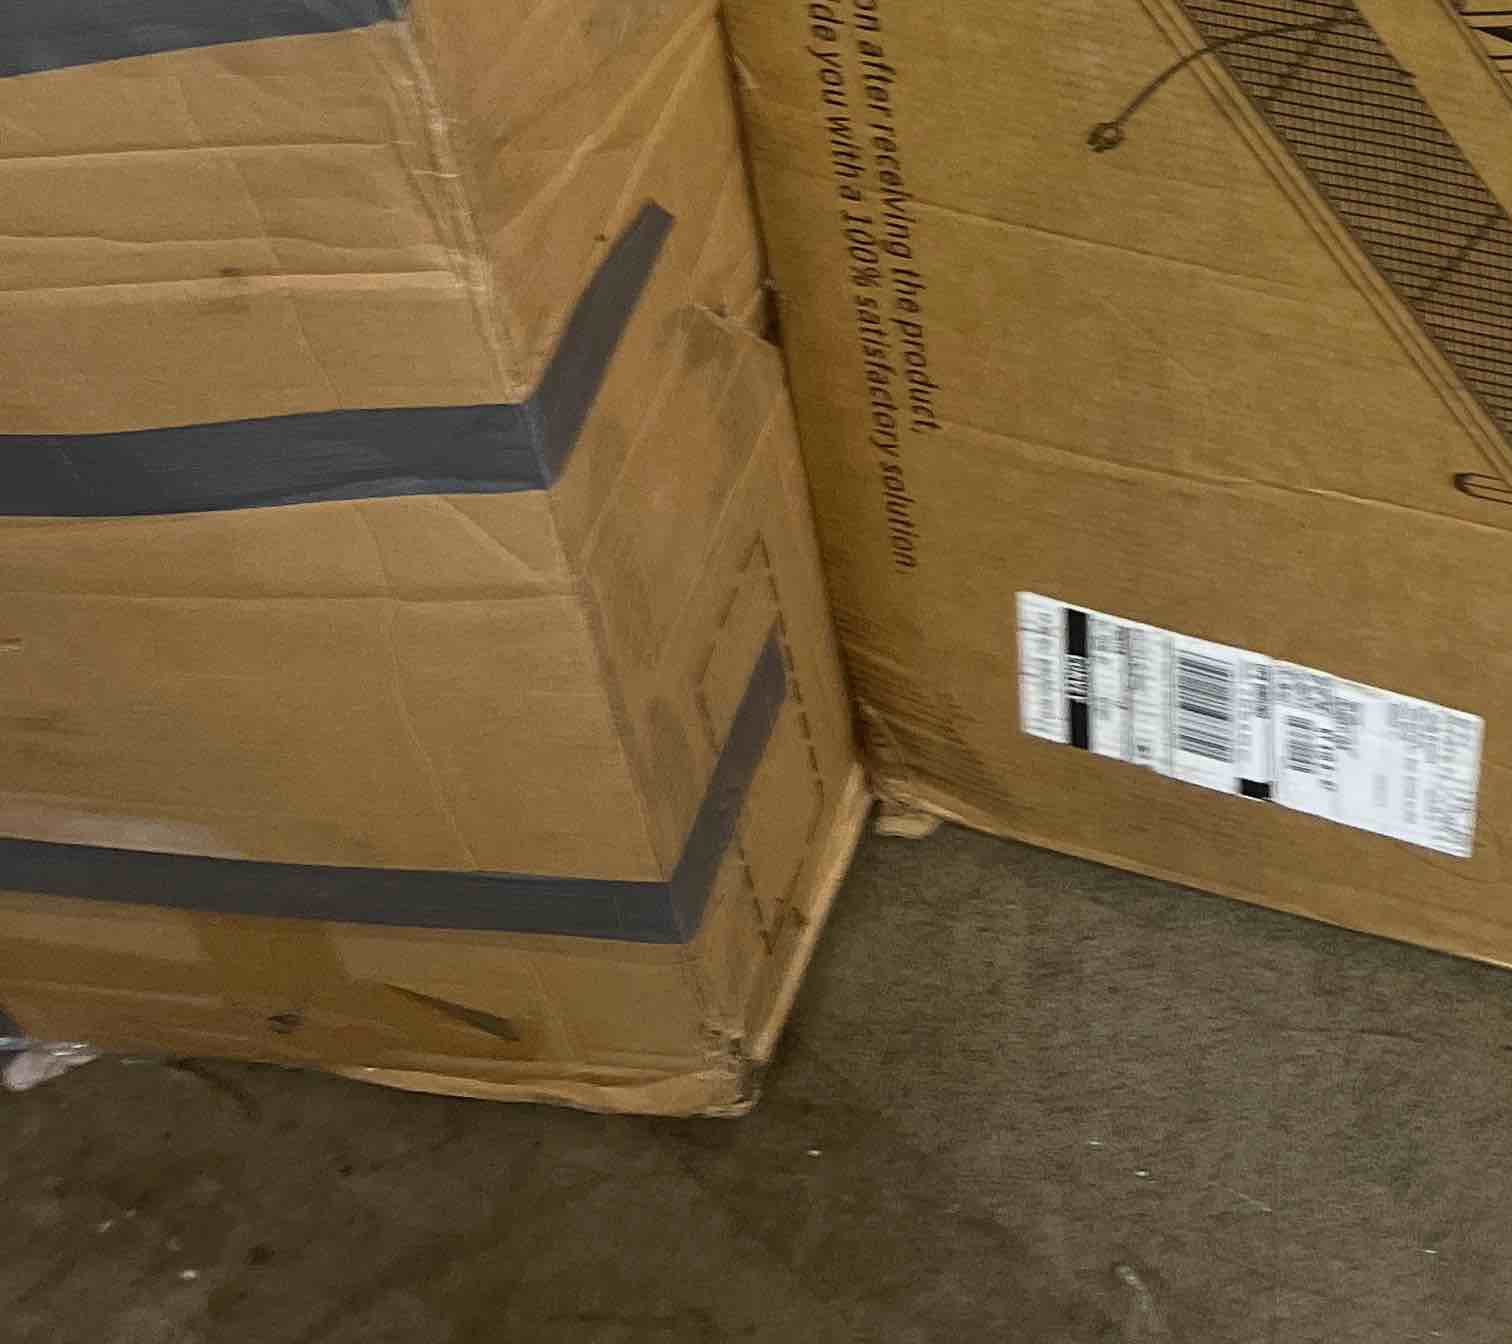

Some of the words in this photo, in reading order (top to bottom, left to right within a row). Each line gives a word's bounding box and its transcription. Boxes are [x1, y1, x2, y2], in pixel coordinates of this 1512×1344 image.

[806, 44, 848, 109] you
[856, 38, 897, 124] after
[827, 114, 866, 177] with
[839, 181, 863, 203] a
[868, 124, 916, 260] receiving
[842, 208, 885, 289] 100%
[890, 268, 927, 314] the
[853, 295, 899, 464] satisfactory
[895, 317, 941, 434] product,
